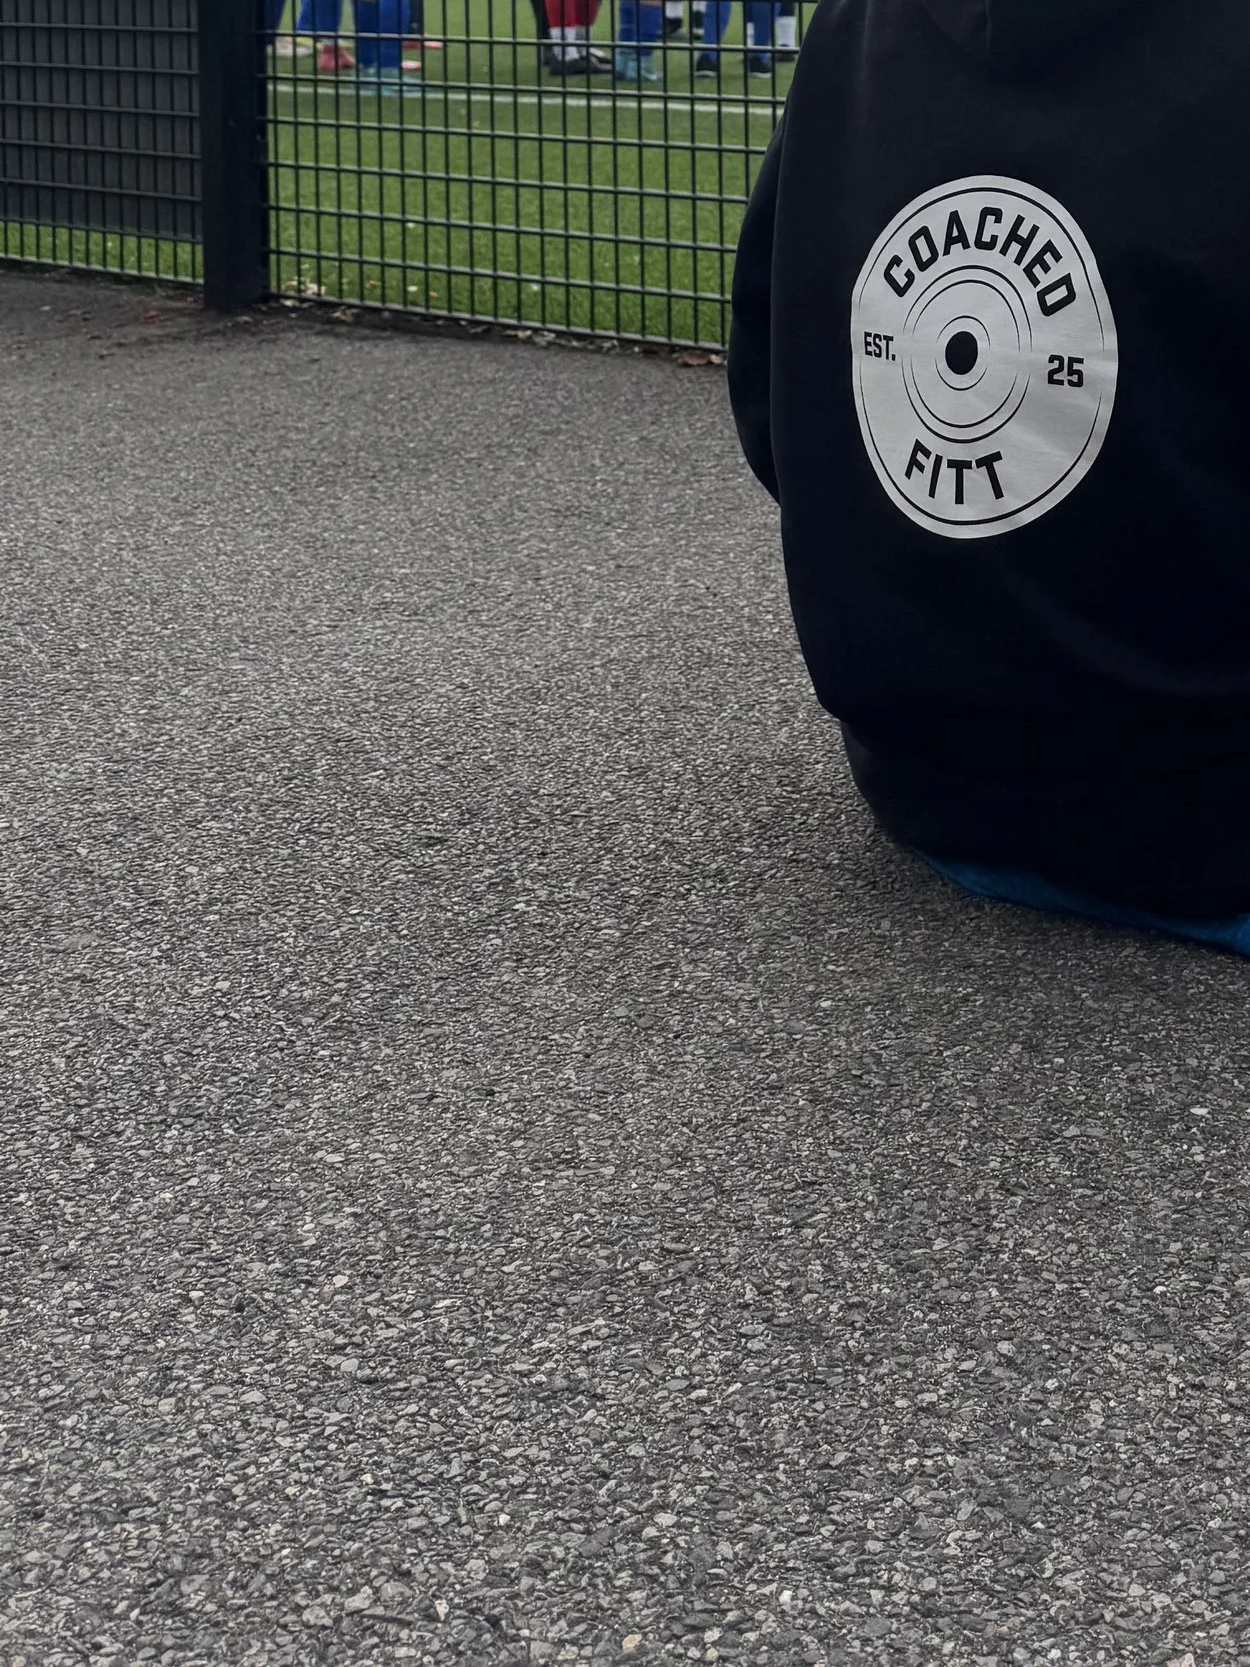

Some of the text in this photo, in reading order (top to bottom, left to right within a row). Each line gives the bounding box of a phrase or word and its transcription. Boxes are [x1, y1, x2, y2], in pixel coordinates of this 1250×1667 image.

[883, 206, 1077, 317] COACHED
[864, 331, 1085, 388] EST. 25
[904, 438, 1005, 505] FITT
